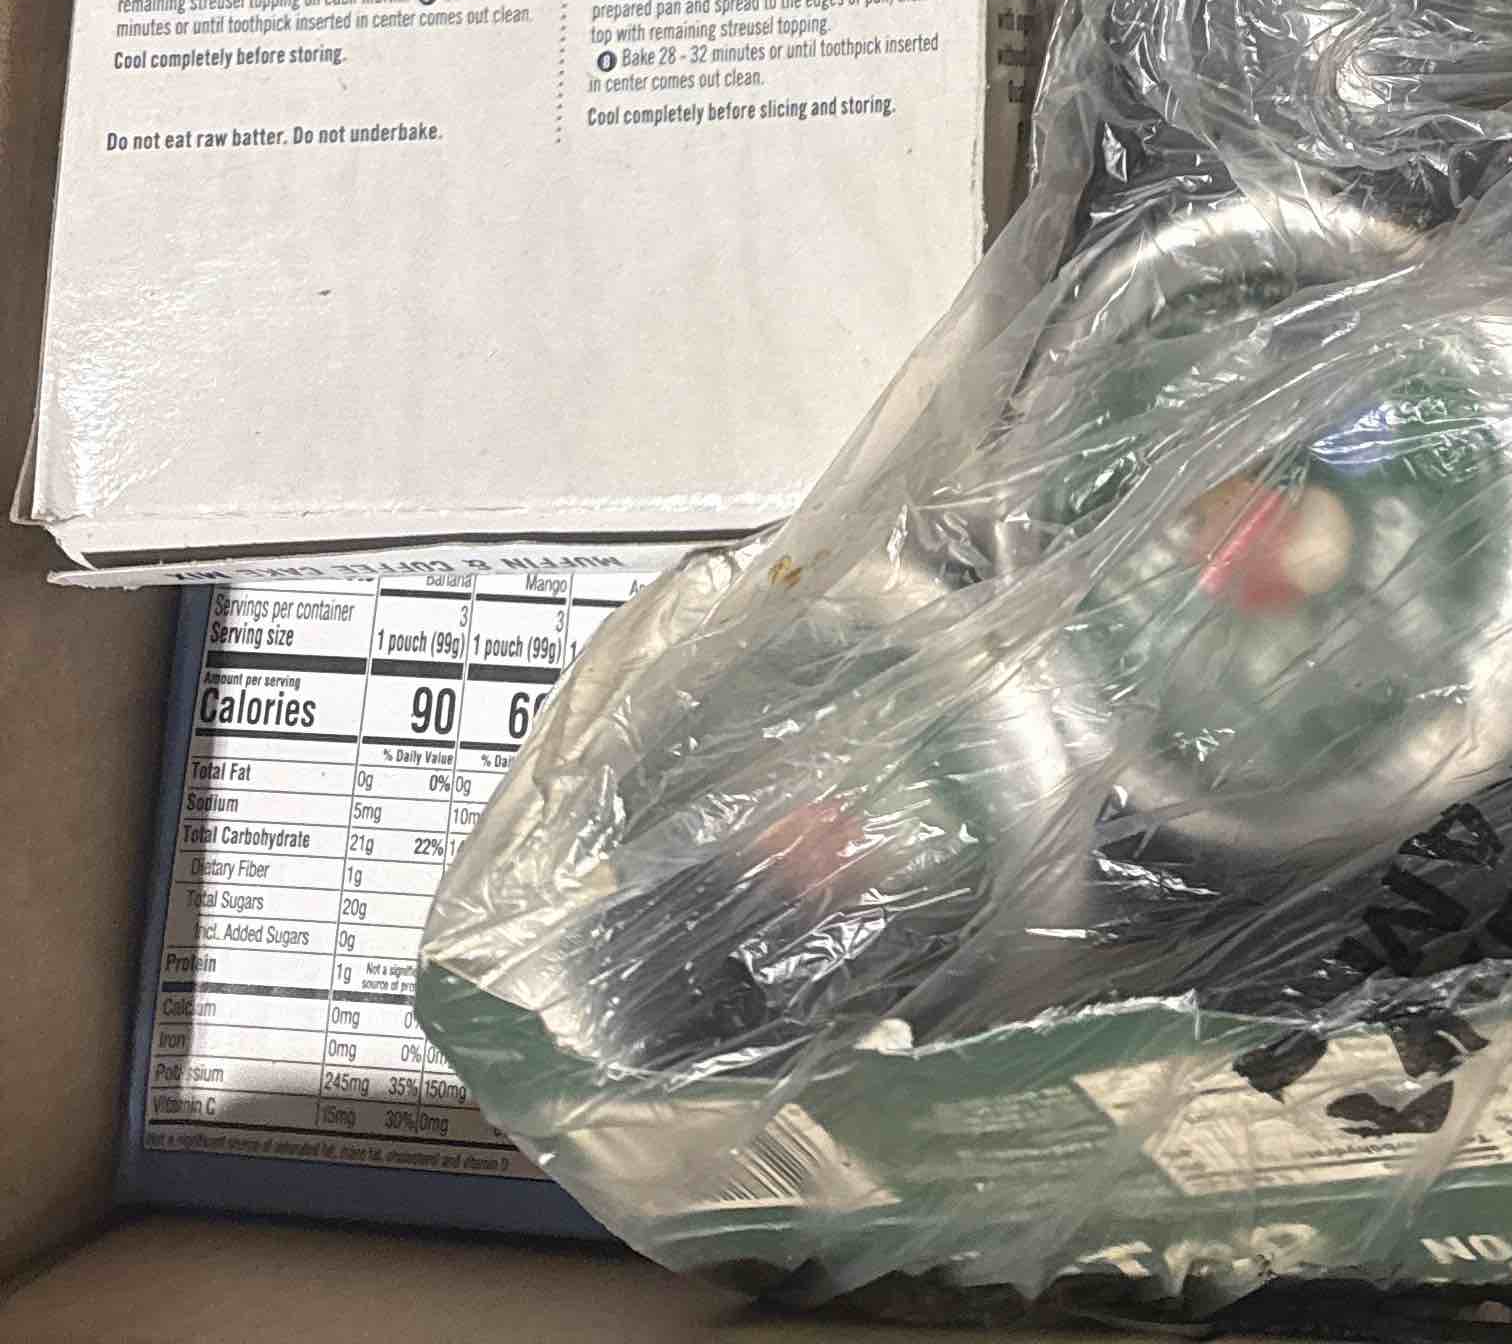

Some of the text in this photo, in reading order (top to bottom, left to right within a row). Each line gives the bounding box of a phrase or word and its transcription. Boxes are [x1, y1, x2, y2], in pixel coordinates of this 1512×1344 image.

[106, 122, 441, 150] Do not eat raw batter. Do not underbake.
[526, 575, 567, 596] Mango
[210, 625, 294, 649] Serving size
[378, 628, 465, 659] 1 pouch (99g)
[199, 686, 456, 735] Calories 90
[191, 761, 251, 782] Total Fat
